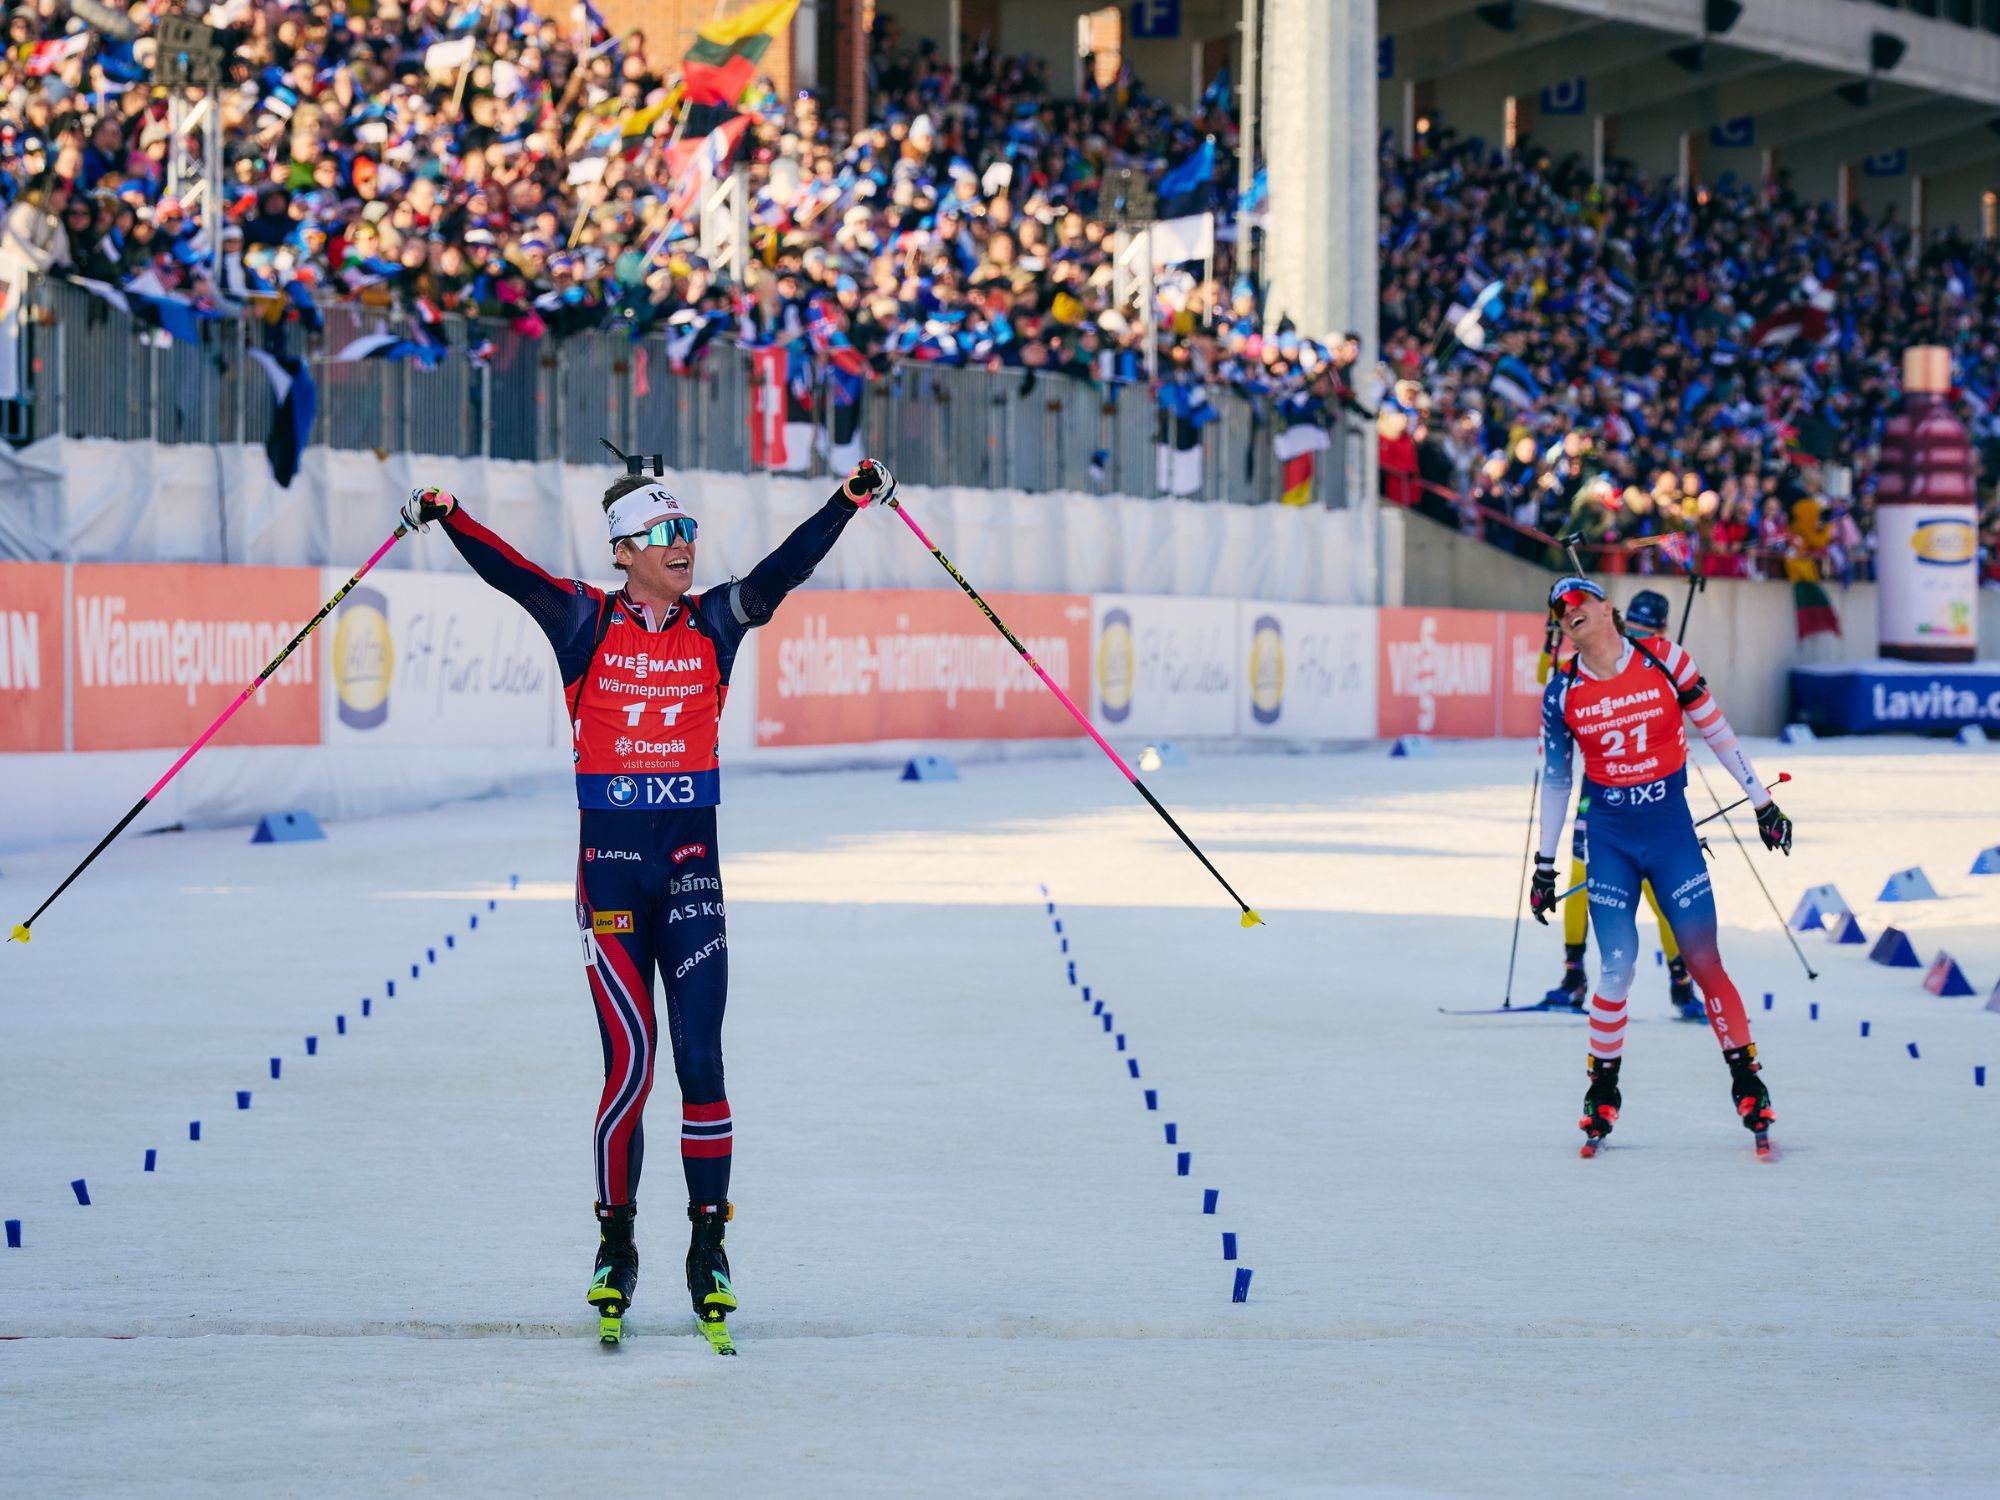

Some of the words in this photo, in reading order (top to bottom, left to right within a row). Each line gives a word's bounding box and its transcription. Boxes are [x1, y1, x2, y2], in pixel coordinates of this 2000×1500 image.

[76, 596, 313, 707] Wärmepumpen
[603, 653, 702, 679] VIESSMANN
[599, 677, 704, 699] Wärmepumpen
[622, 702, 684, 727] 11
[1575, 688, 1661, 719] VIESSMANN
[1577, 707, 1664, 735] Wärmepumpen
[634, 739, 686, 757] Otepää
[1600, 722, 1648, 758] 21
[622, 760, 644, 769] visit
[645, 758, 680, 769] estonia
[1618, 757, 1659, 775] Otepää
[646, 775, 695, 804] iX3
[1630, 780, 1666, 805] iX3
[597, 850, 642, 861] LAPUA
[674, 845, 703, 860] MENY
[596, 919, 613, 927] Uno
[617, 916, 629, 928] X
[675, 938, 720, 979] CRAFT
[1709, 997, 1737, 1050] USA
